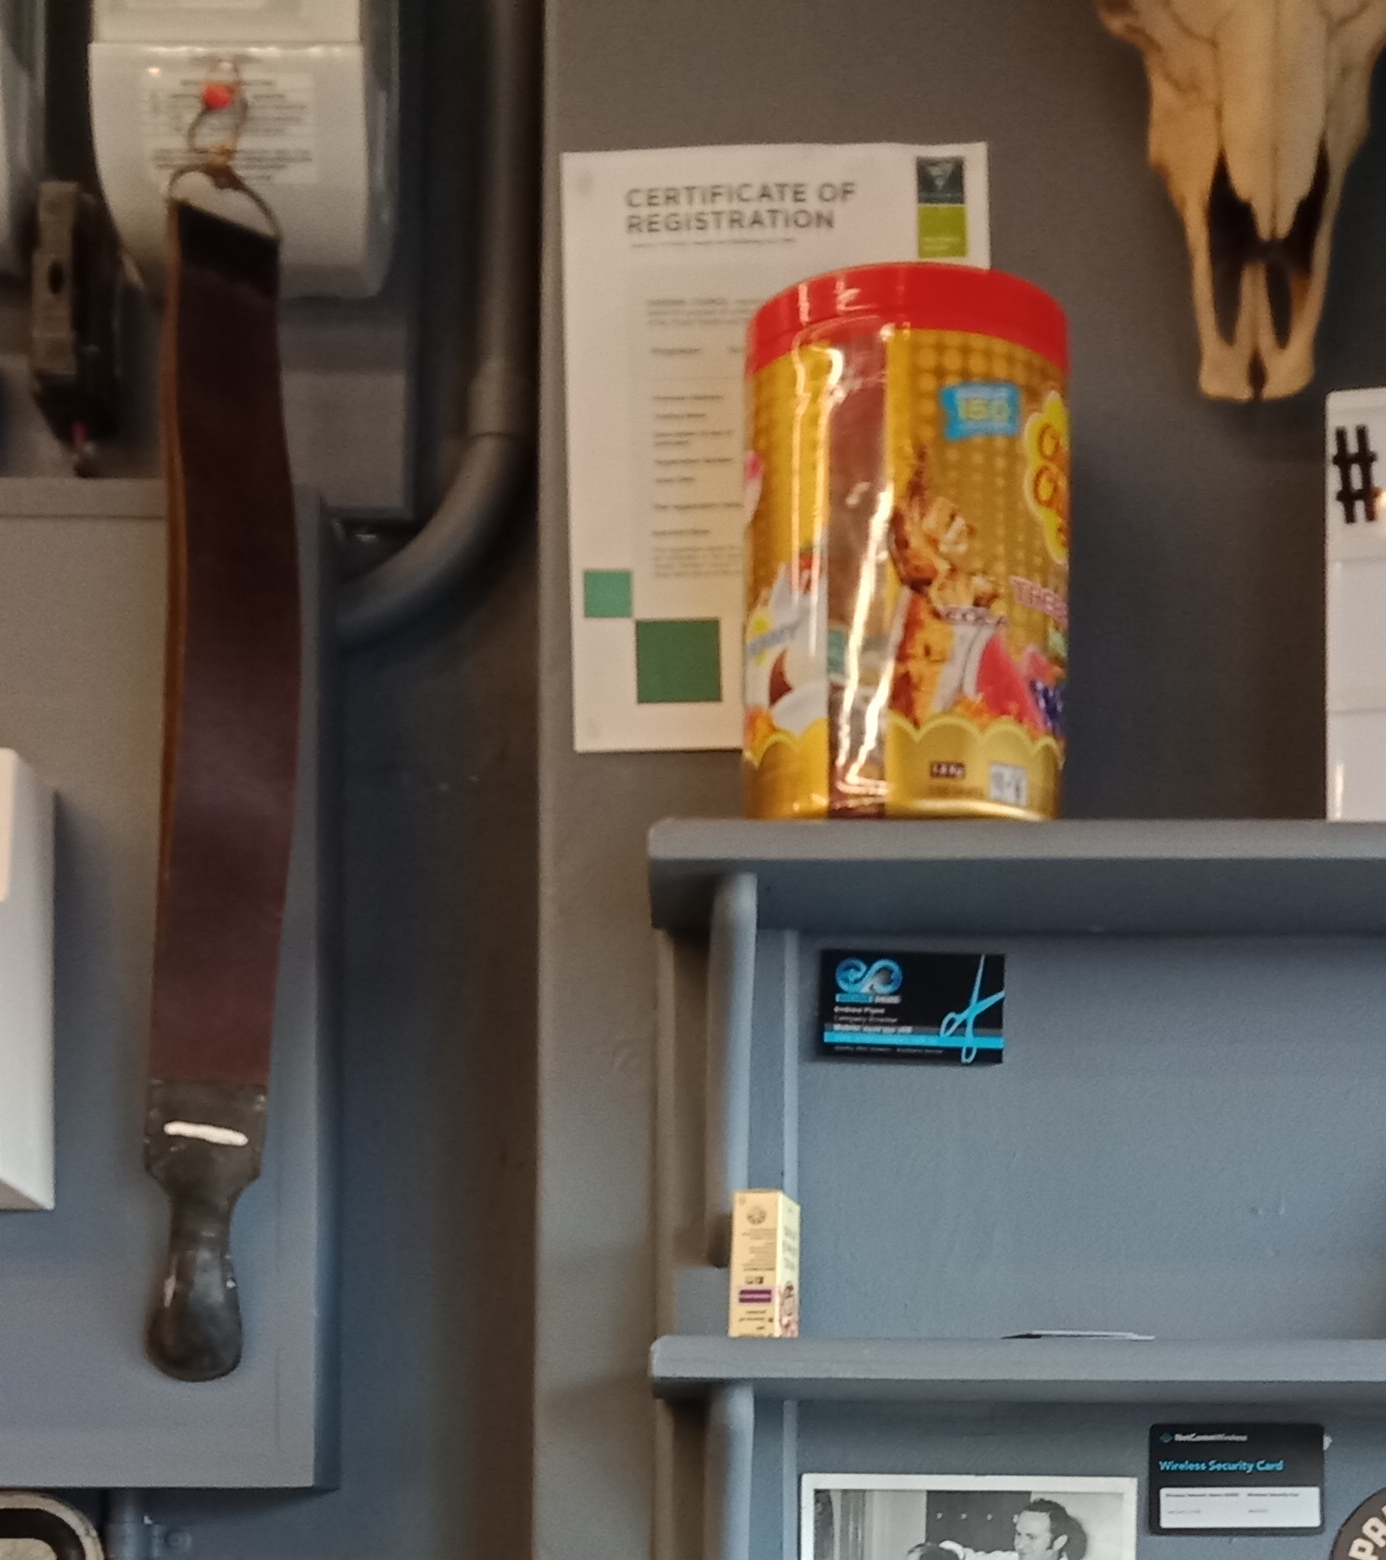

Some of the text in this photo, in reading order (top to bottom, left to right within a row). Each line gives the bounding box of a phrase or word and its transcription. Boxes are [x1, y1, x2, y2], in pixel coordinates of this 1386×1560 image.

[624, 181, 856, 208] CERTIFICATE OF
[625, 209, 835, 234] REGISTRATION
[1159, 1460, 1284, 1473] Wireless Security Card
